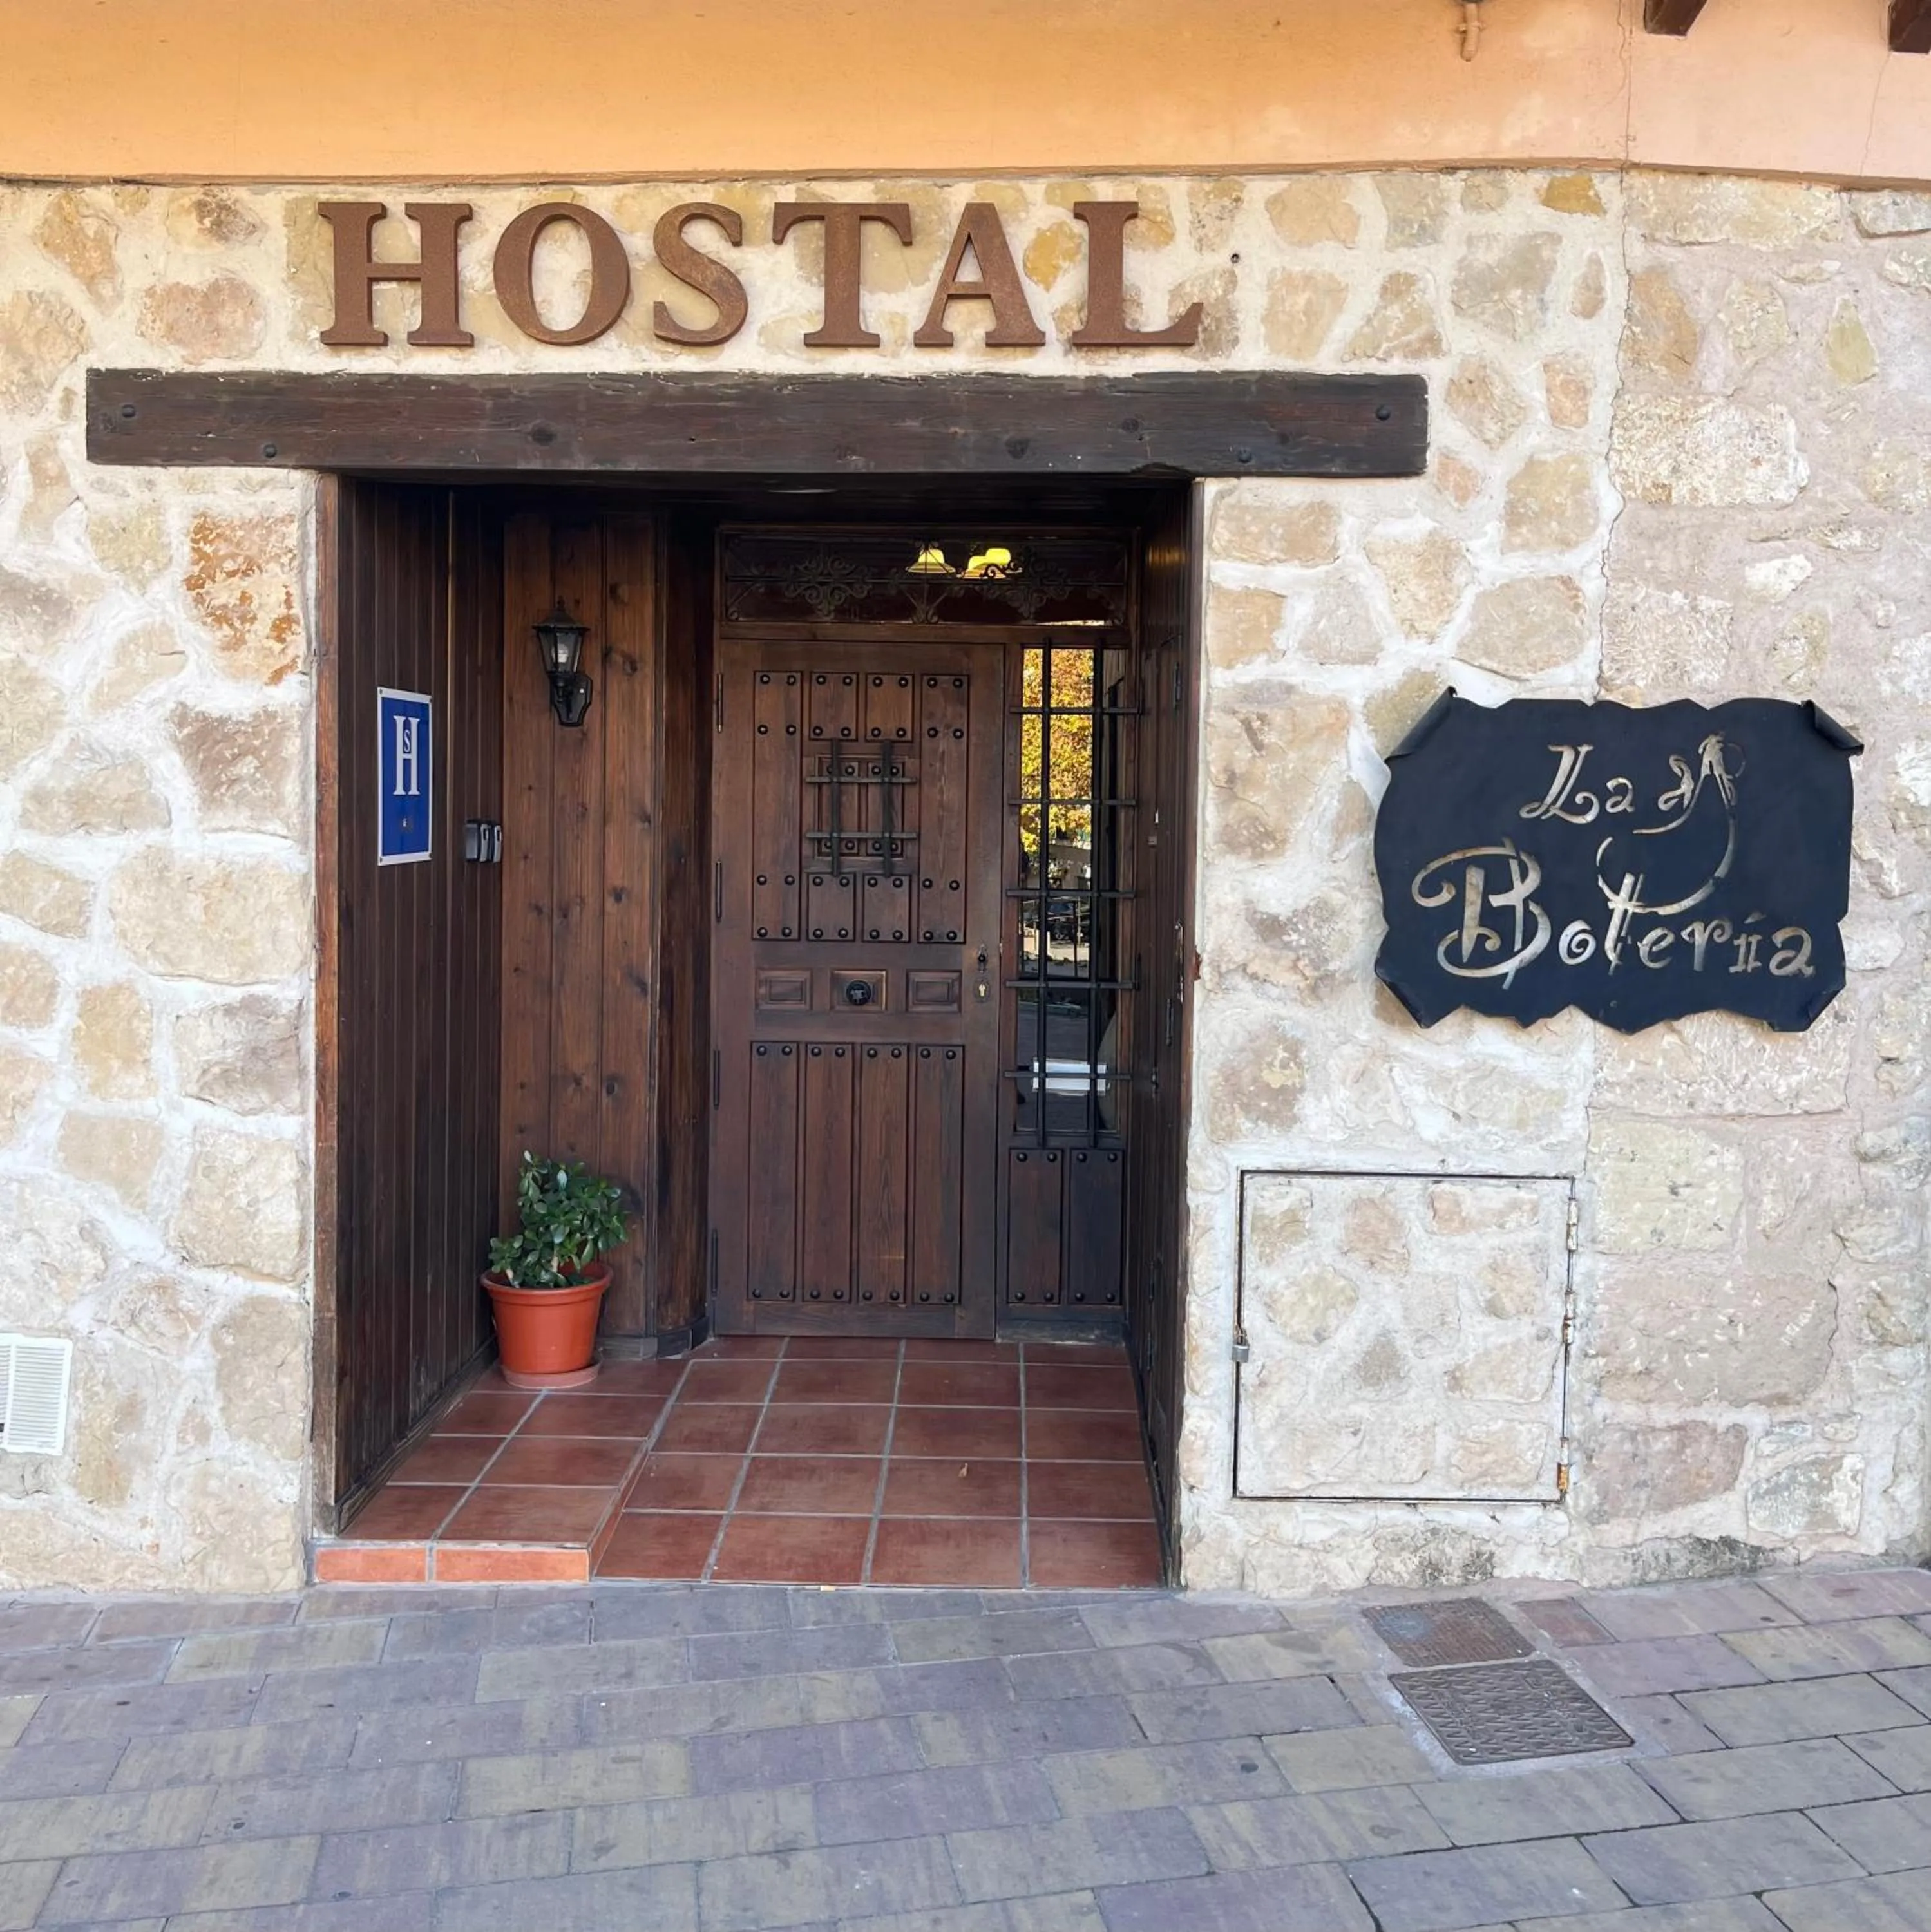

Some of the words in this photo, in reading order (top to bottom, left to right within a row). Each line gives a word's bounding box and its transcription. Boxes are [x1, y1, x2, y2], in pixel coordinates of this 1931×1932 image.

[318, 201, 1204, 348] HOSTAL
[1520, 743, 1635, 824] La
[1411, 836, 1816, 990] Botería
